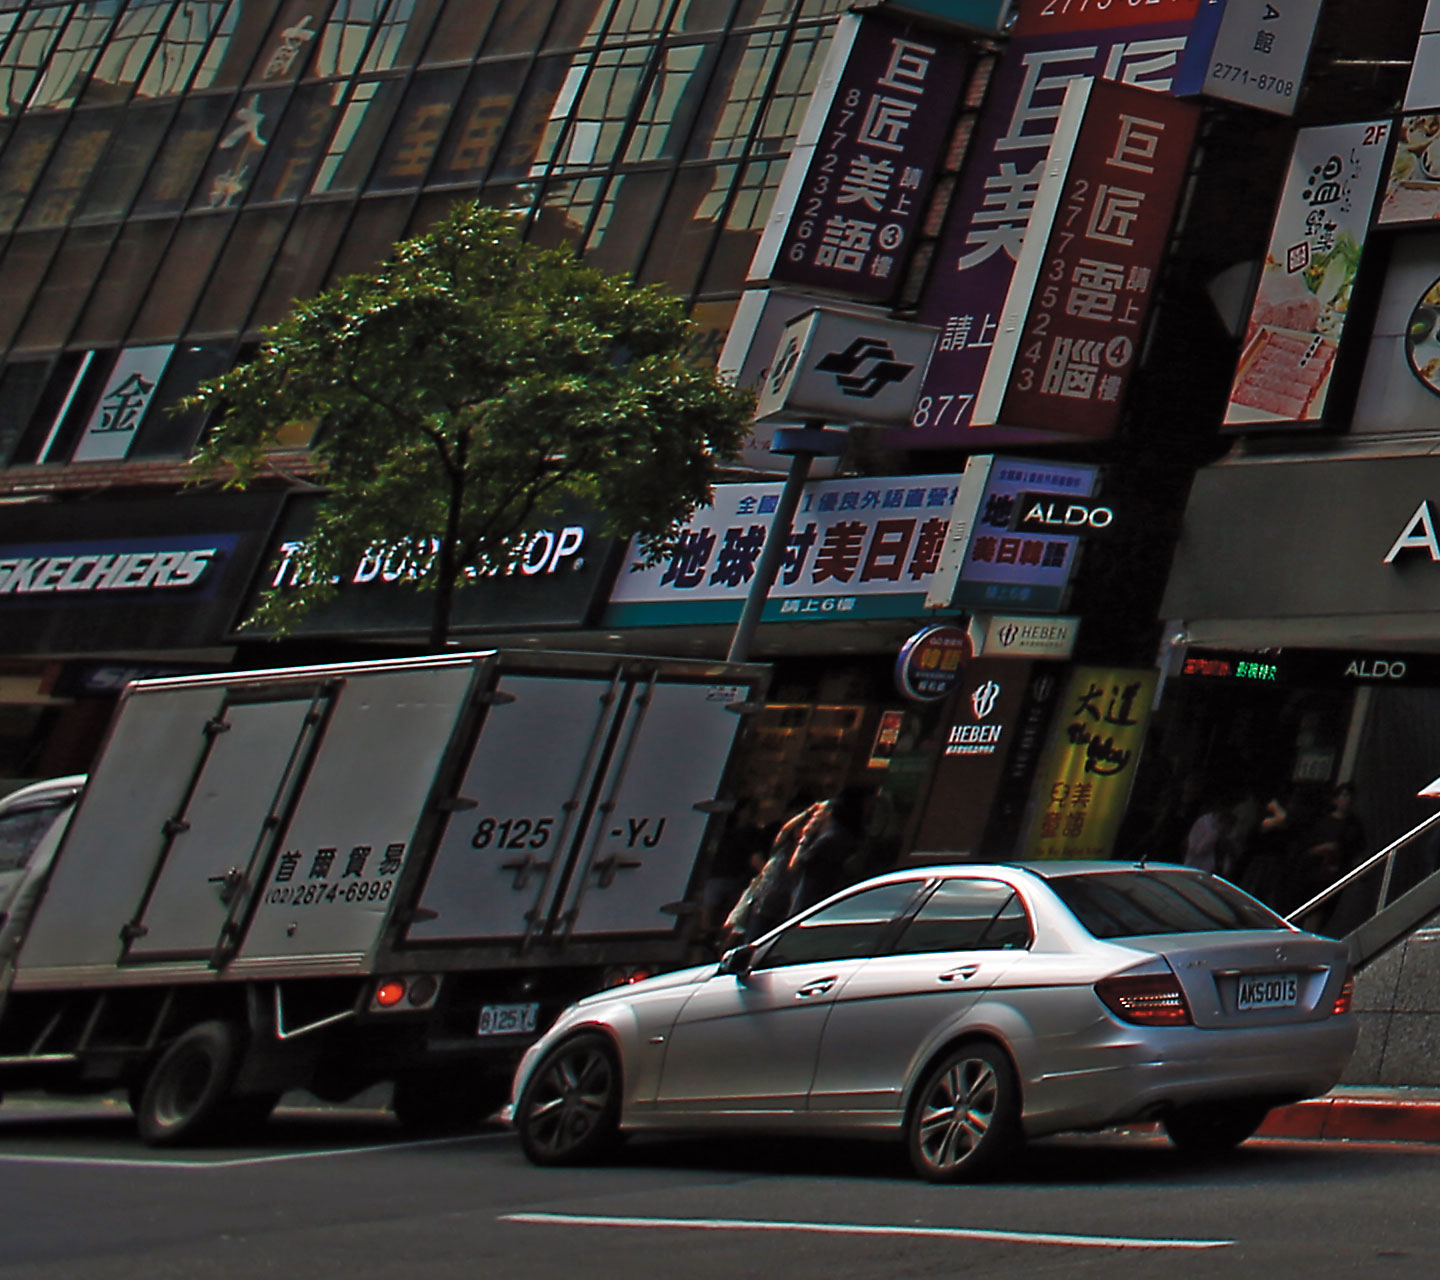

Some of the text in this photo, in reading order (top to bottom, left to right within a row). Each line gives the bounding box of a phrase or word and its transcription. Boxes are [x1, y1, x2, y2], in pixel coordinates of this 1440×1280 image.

[1212, 60, 1295, 99] 2771-8708
[1362, 125, 1388, 146] 2F
[814, 37, 937, 273] 巨匠美語
[1040, 113, 1165, 401] 巨匠電腦
[90, 372, 155, 435] 金
[1023, 500, 1114, 528] ALDO
[1021, 626, 1067, 640] HEBEN
[1344, 660, 1407, 678] ALDO
[949, 725, 1002, 745] HEBEN
[470, 818, 554, 851] 8125
[274, 843, 407, 883] 首爾貿易
